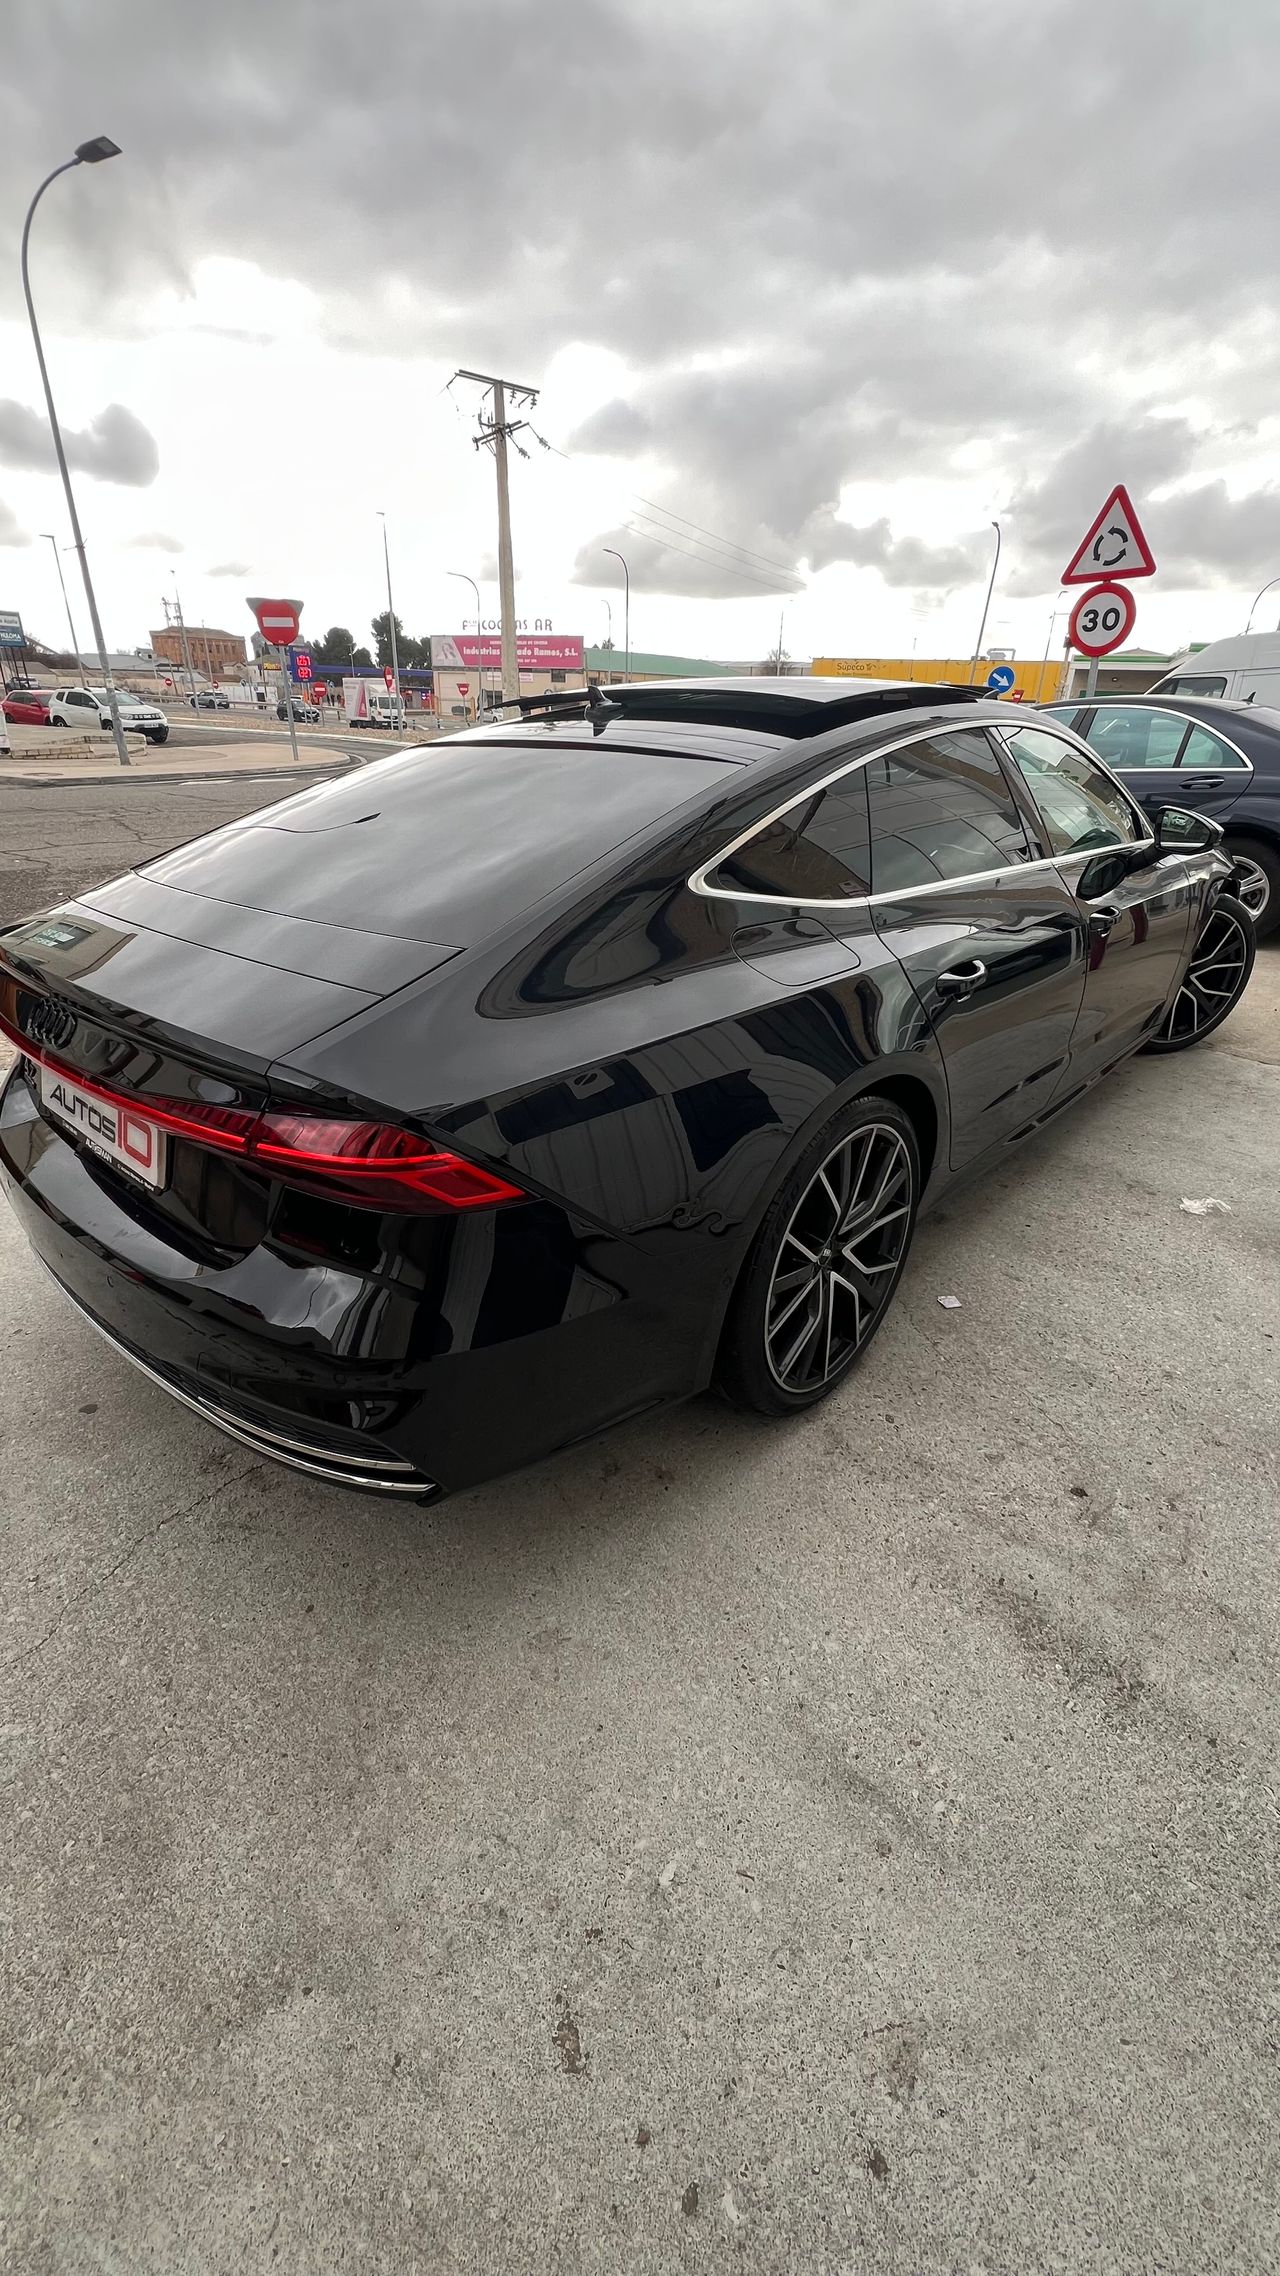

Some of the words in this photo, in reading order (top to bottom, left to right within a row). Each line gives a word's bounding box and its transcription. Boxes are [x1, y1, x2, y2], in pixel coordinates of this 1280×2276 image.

[535, 618, 553, 631] AR
[1082, 607, 1120, 632] 30
[463, 646, 500, 656] Industrias
[564, 648, 579, 657] S.L.
